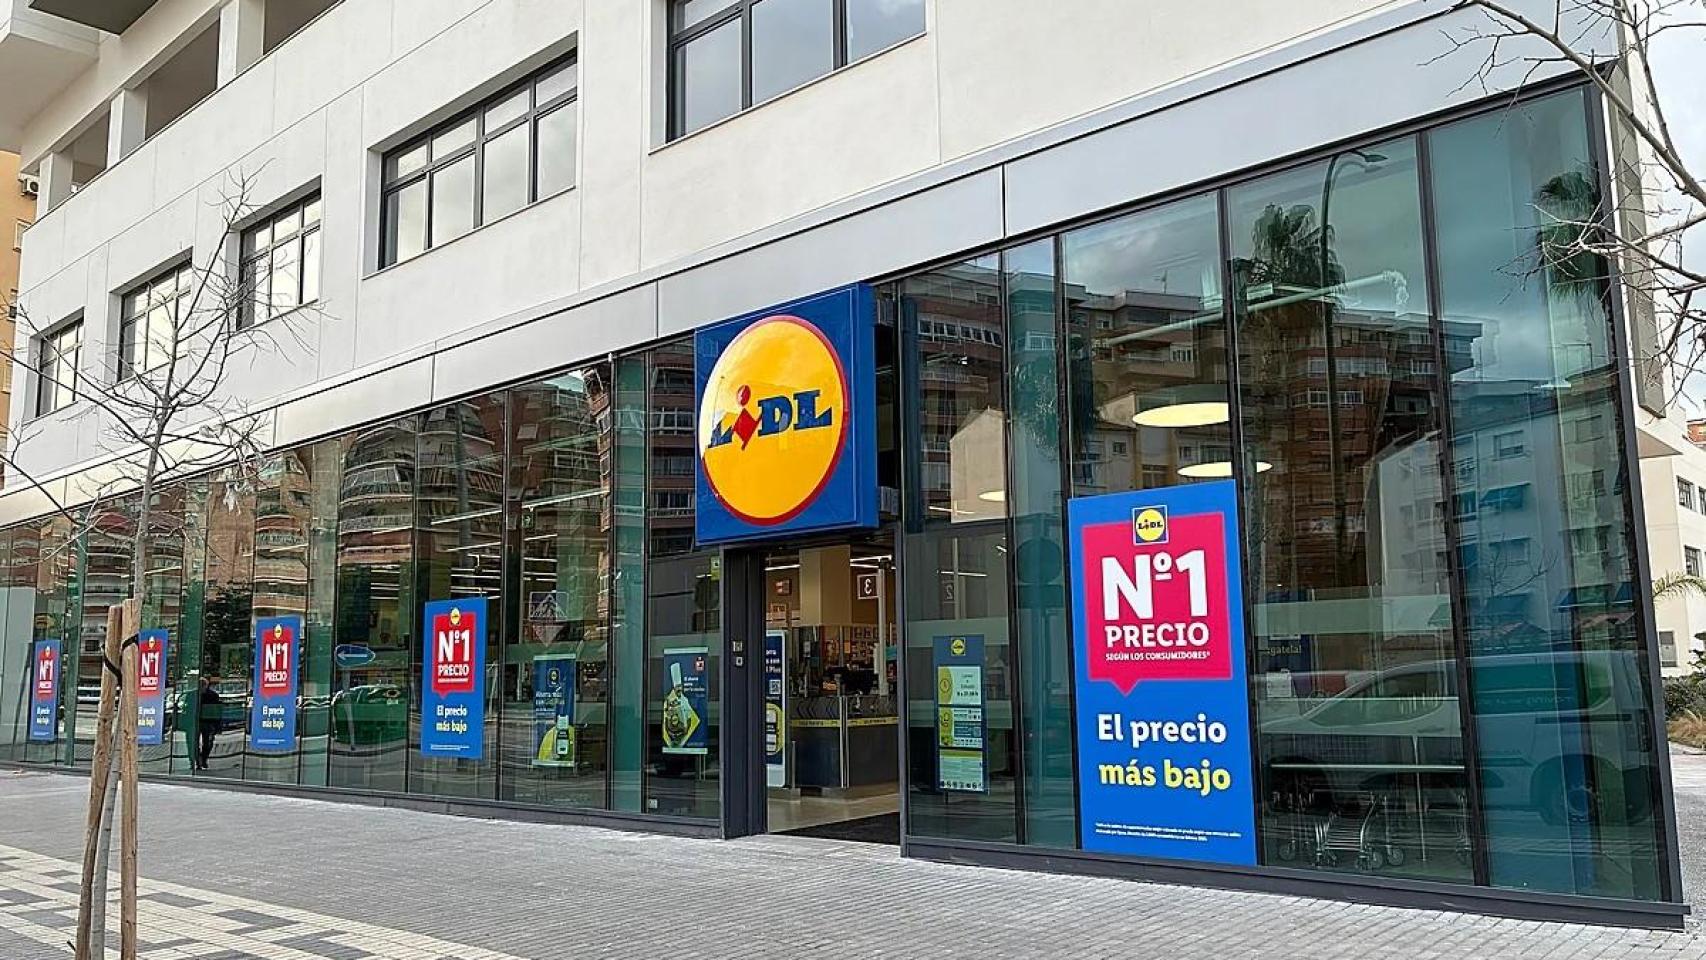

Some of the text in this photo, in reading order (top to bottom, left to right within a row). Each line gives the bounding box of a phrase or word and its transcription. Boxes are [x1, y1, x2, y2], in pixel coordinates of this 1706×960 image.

[1104, 622, 1210, 648] PRECIO
[1131, 652, 1144, 661] LOS
[264, 671, 287, 682] PRECIO
[438, 664, 469, 676] PRECIO
[437, 704, 467, 718] El precio
[436, 719, 467, 734] más bajo
[1098, 714, 1226, 748] El precio
[1099, 759, 1231, 796] más bajo
